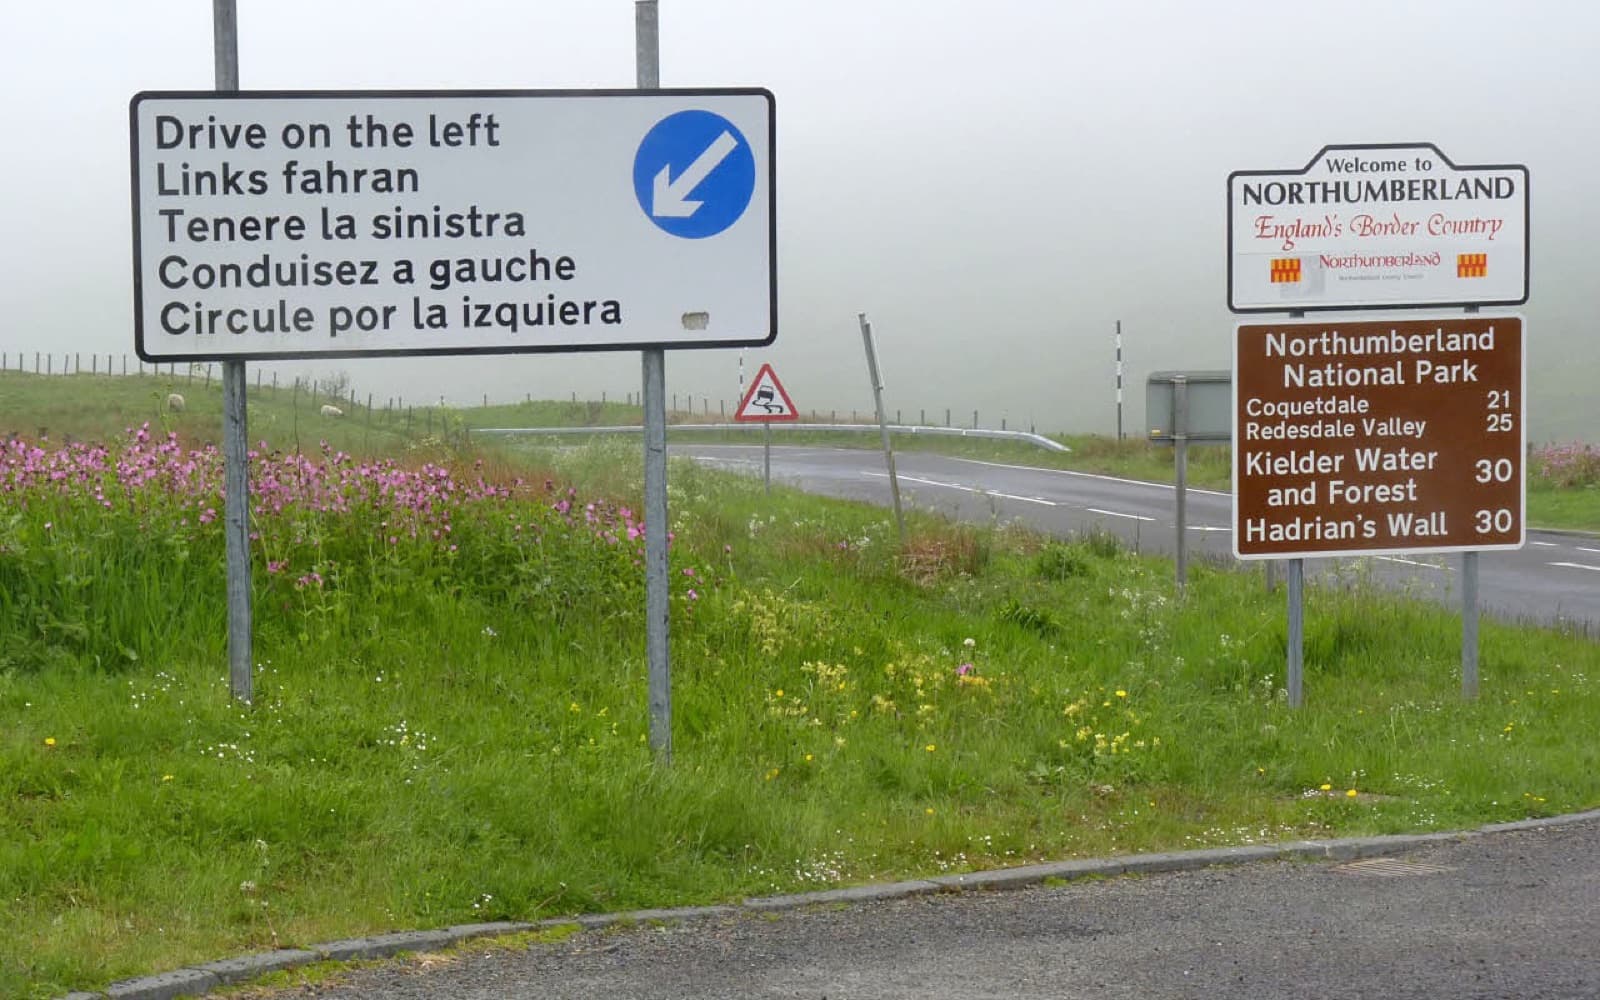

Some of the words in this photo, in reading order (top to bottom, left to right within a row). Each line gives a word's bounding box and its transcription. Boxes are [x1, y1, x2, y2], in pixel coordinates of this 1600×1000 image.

[156, 116, 266, 149] Drive
[282, 124, 330, 149] on
[347, 115, 413, 148] the
[430, 114, 499, 147] left
[158, 162, 267, 195] Links
[283, 161, 418, 194] fahran
[1327, 157, 1406, 173] Welcome
[1416, 158, 1431, 171] to
[1243, 176, 1515, 206] NORTHUMBERLAND
[159, 209, 305, 242] Tenere
[322, 207, 356, 240] la
[372, 206, 525, 239] sinistra
[1254, 214, 1342, 251] England's
[1350, 213, 1418, 238] Border
[1427, 213, 1504, 240] Country
[159, 254, 378, 289] Conduisez
[393, 260, 414, 284] a
[430, 249, 575, 290] gauche
[161, 300, 314, 335] Circule
[330, 306, 396, 337] por
[414, 297, 448, 329] la
[464, 294, 621, 332] izquiera
[1266, 327, 1493, 356] Northumberland
[1285, 361, 1404, 387] National
[1417, 359, 1477, 383] Park
[1246, 395, 1370, 419] Coquetdale
[1488, 391, 1509, 408] 21
[1247, 420, 1355, 440] Redesdale
[1363, 418, 1426, 438] Valley
[1487, 414, 1512, 431] 25
[1247, 450, 1344, 475] Kielder
[1355, 448, 1437, 471] Water
[1476, 459, 1512, 483] 30
[1268, 481, 1315, 506] and
[1330, 478, 1416, 504] Forest
[1247, 514, 1376, 541] Hadrian's
[1388, 512, 1448, 536] Wall
[1476, 509, 1512, 533] 30
